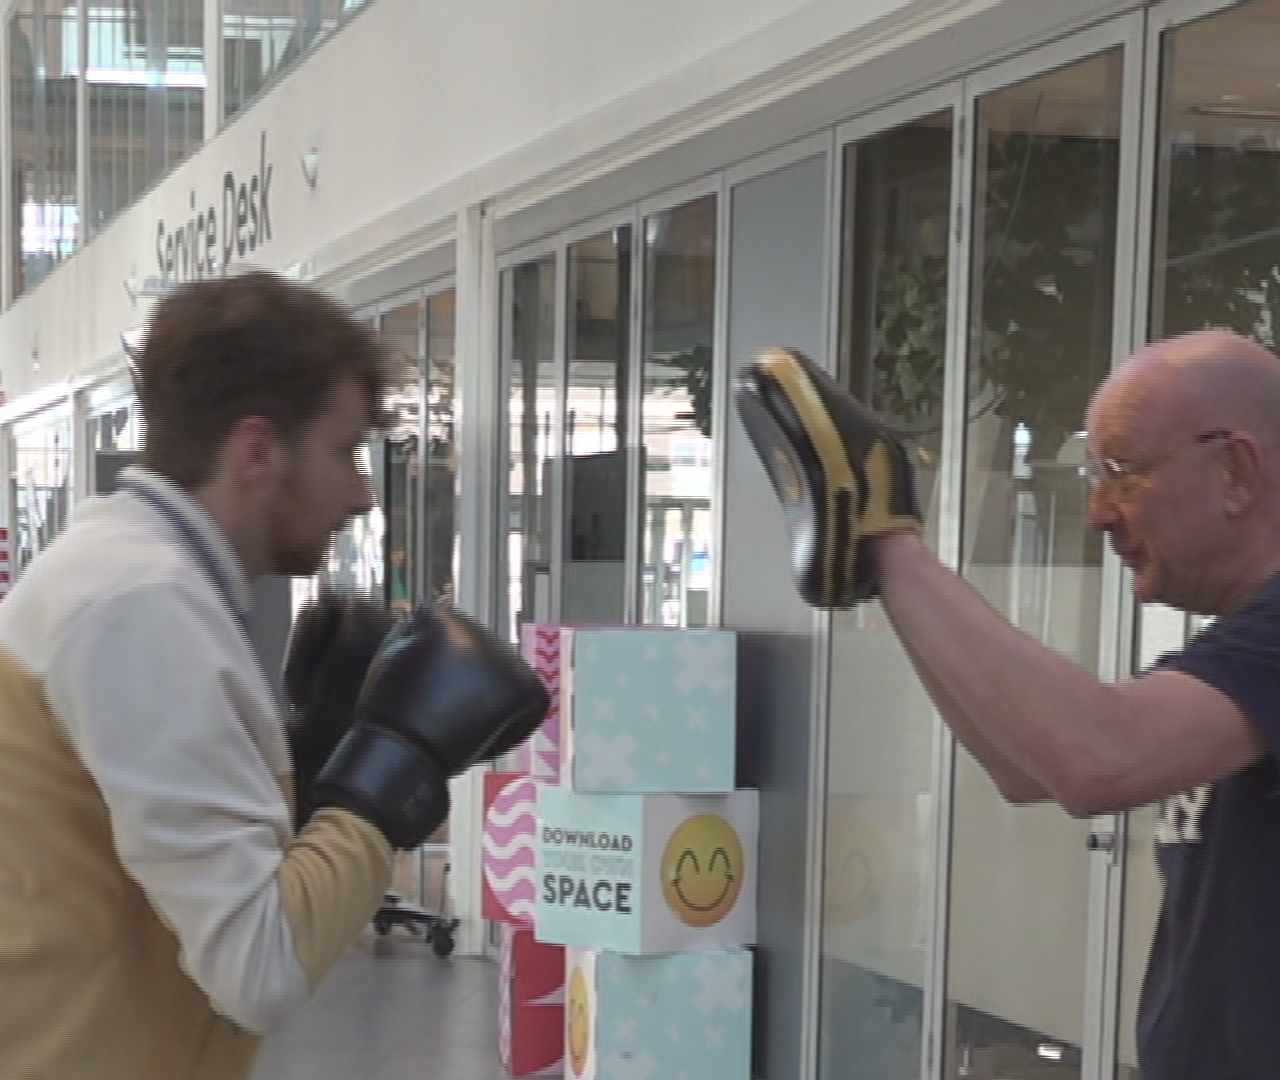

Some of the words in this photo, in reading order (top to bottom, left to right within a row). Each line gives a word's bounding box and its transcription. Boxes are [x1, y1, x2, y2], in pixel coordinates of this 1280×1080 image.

[156, 188, 217, 284] Service
[223, 131, 272, 272] Desk
[542, 826, 633, 853] DOWNLOAD
[542, 872, 632, 915] SPACE
